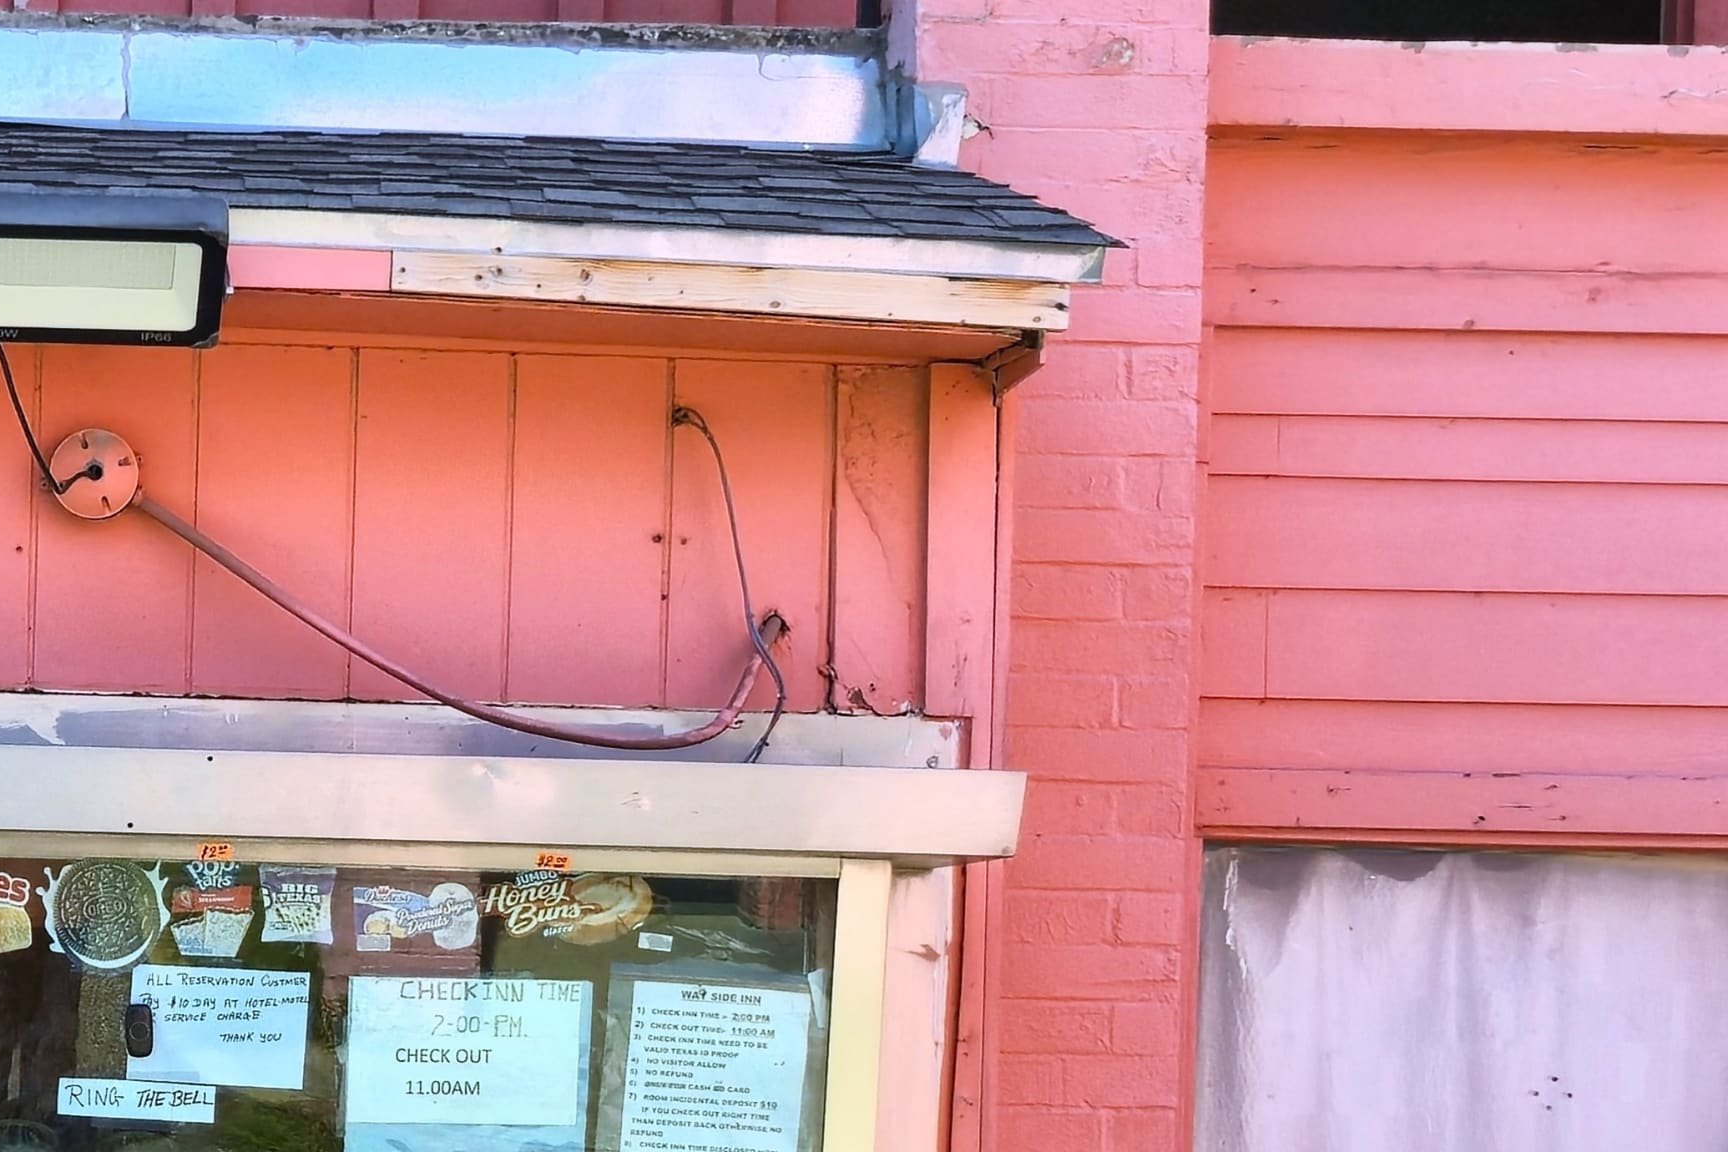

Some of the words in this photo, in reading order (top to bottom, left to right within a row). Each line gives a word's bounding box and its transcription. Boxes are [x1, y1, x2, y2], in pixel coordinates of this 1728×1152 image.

[515, 870, 559, 887] JUMBO
[281, 883, 319, 894] BIG
[278, 893, 322, 904] TEXAS
[481, 880, 570, 914] Honey
[87, 901, 123, 917] OREO
[396, 903, 444, 925] Powdered
[407, 914, 450, 936] Donuts
[506, 902, 595, 937] Buns
[146, 972, 173, 987] ALL
[177, 972, 254, 988] RESERVATION
[536, 982, 580, 1002] TIME
[681, 988, 707, 1000] WAY
[711, 992, 737, 1003] SIDE
[740, 994, 762, 1004] INN
[223, 998, 239, 1009] AT
[164, 1012, 207, 1022] SERVICE
[216, 1011, 261, 1021] CHARGE
[637, 1006, 645, 1015] 1)
[651, 1008, 681, 1017] CHECK
[700, 1011, 720, 1019] TIME
[634, 1020, 644, 1029] 2)
[650, 1022, 679, 1031] CHECK
[681, 1024, 699, 1032] OUT
[759, 1029, 775, 1037] AM
[219, 1032, 253, 1043] THANK
[259, 1032, 282, 1043] YOU
[647, 1034, 676, 1043] CHECK
[697, 1037, 716, 1045] TIME
[395, 1048, 450, 1064] CHECK
[455, 1048, 492, 1064] OUT
[644, 1046, 669, 1055] VALID
[671, 1048, 698, 1056] TEXAS
[711, 1050, 739, 1058] PROOF
[661, 1059, 694, 1067] VISITOR
[696, 1061, 726, 1069] ALLOW
[660, 1070, 694, 1079] REFUND
[405, 1080, 480, 1096] 11.00AM
[64, 1084, 124, 1108] RING
[136, 1089, 169, 1108] THE
[170, 1089, 214, 1108] BELL
[669, 1096, 720, 1105] INCIDENTAL
[722, 1099, 758, 1108] DEPOSIT
[671, 1108, 700, 1116] CHECK
[632, 1117, 654, 1125] THAN
[656, 1119, 692, 1127] DEPOSIT
[639, 1141, 668, 1149] CHECK
